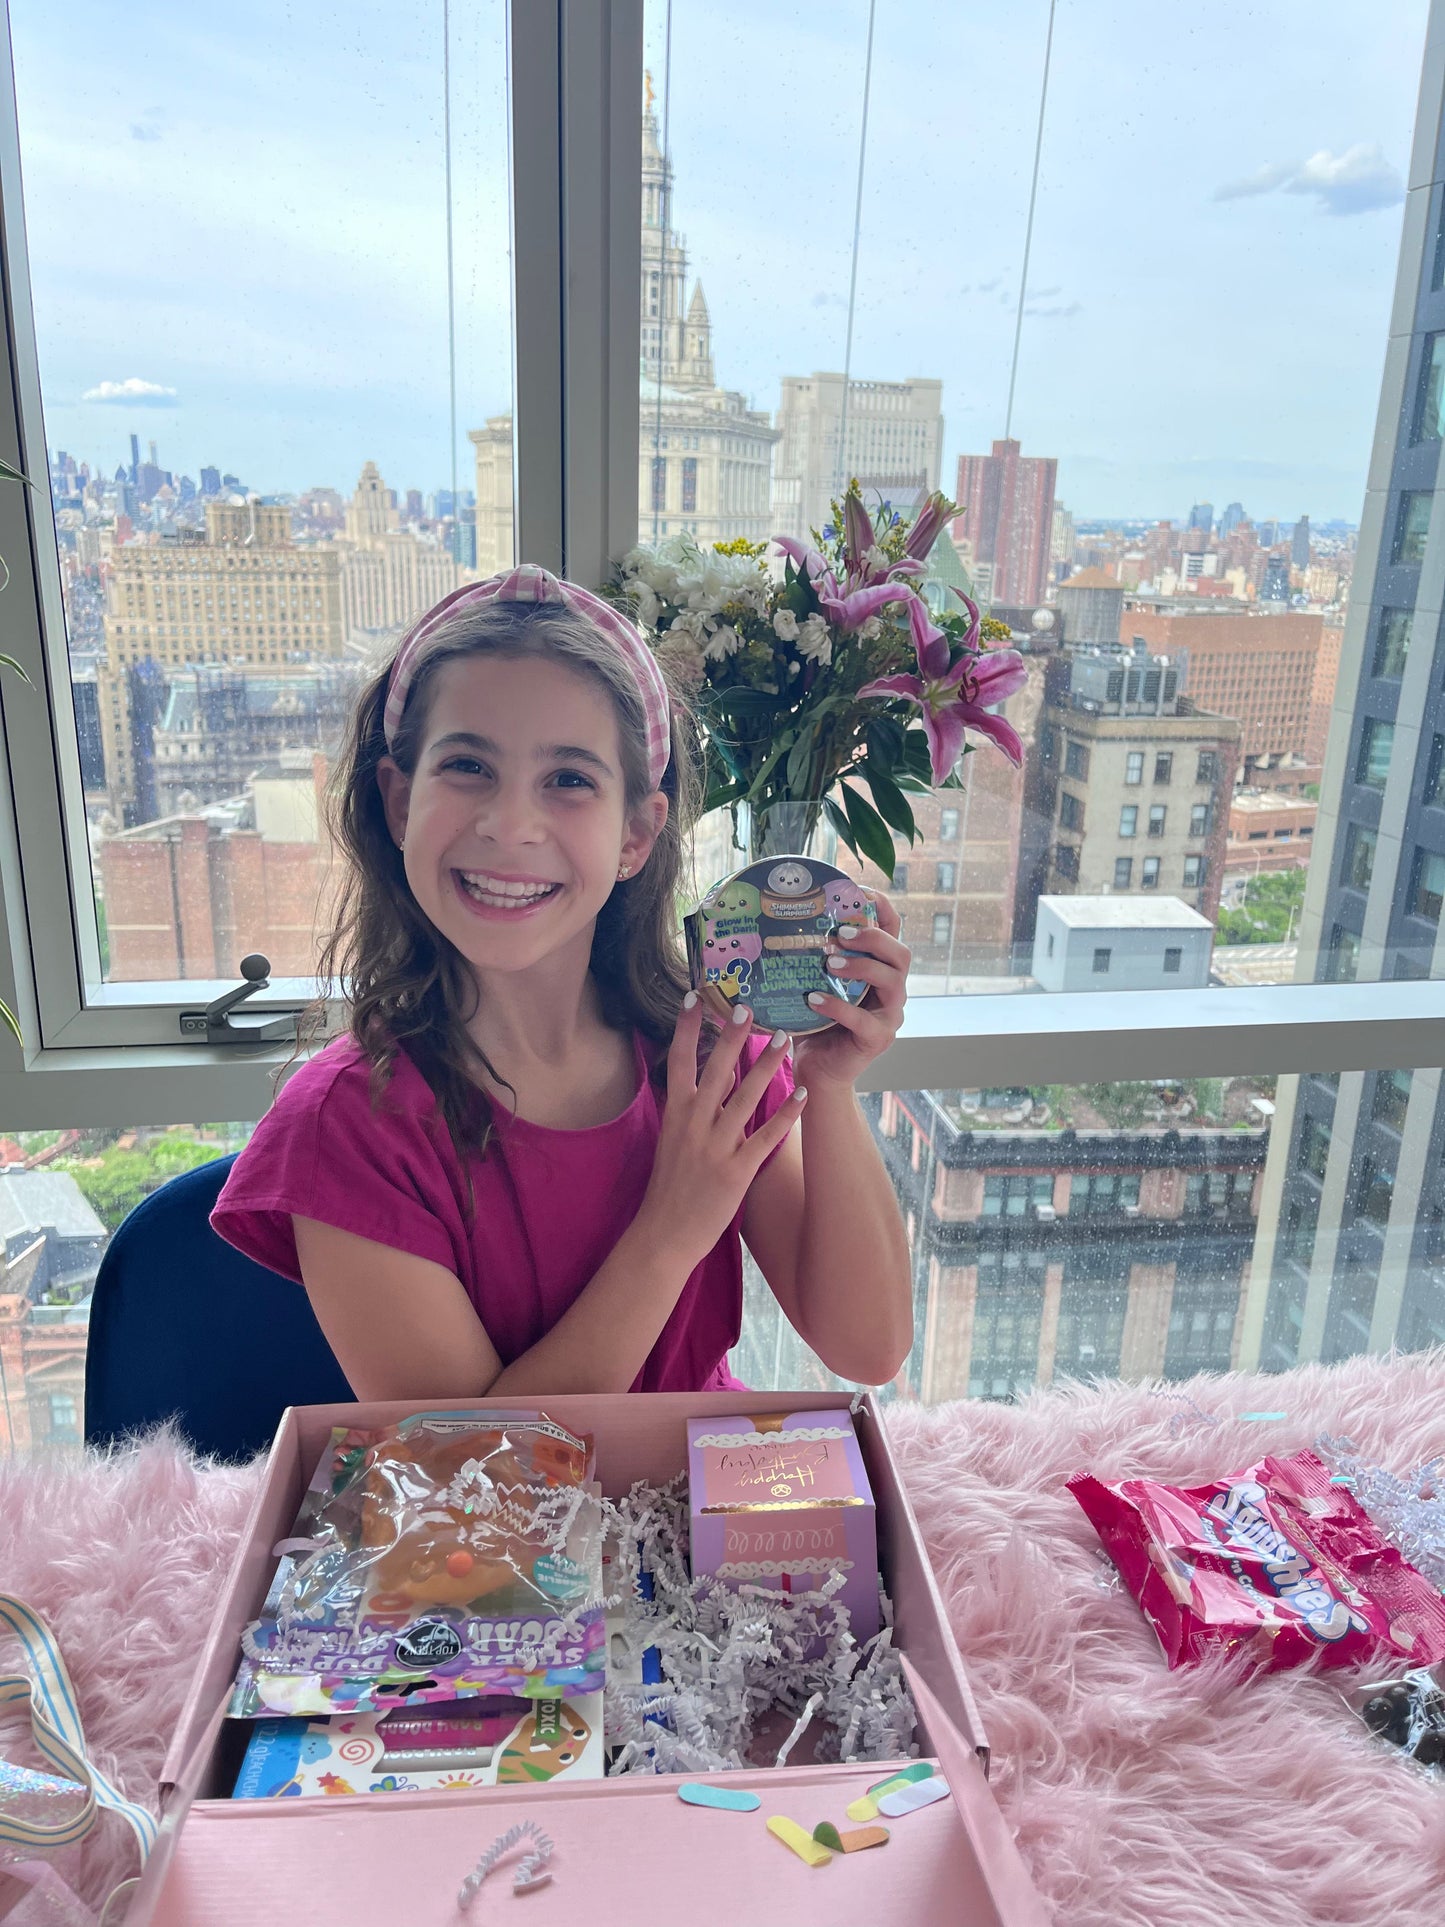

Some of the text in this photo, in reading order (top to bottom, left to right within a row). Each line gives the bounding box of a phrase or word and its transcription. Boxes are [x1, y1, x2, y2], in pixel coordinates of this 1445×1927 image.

[771, 902, 816, 911] SHIMMERING
[716, 917, 754, 928] Glow in
[715, 928, 730, 937] the
[766, 968, 822, 980] SQUISHY
[760, 980, 828, 993] DUMPLINGS
[715, 1442, 830, 1472] Birthday
[734, 1465, 816, 1488] Happy
[436, 1645, 454, 1655] TOP
[540, 1699, 556, 1734] TOXIC
